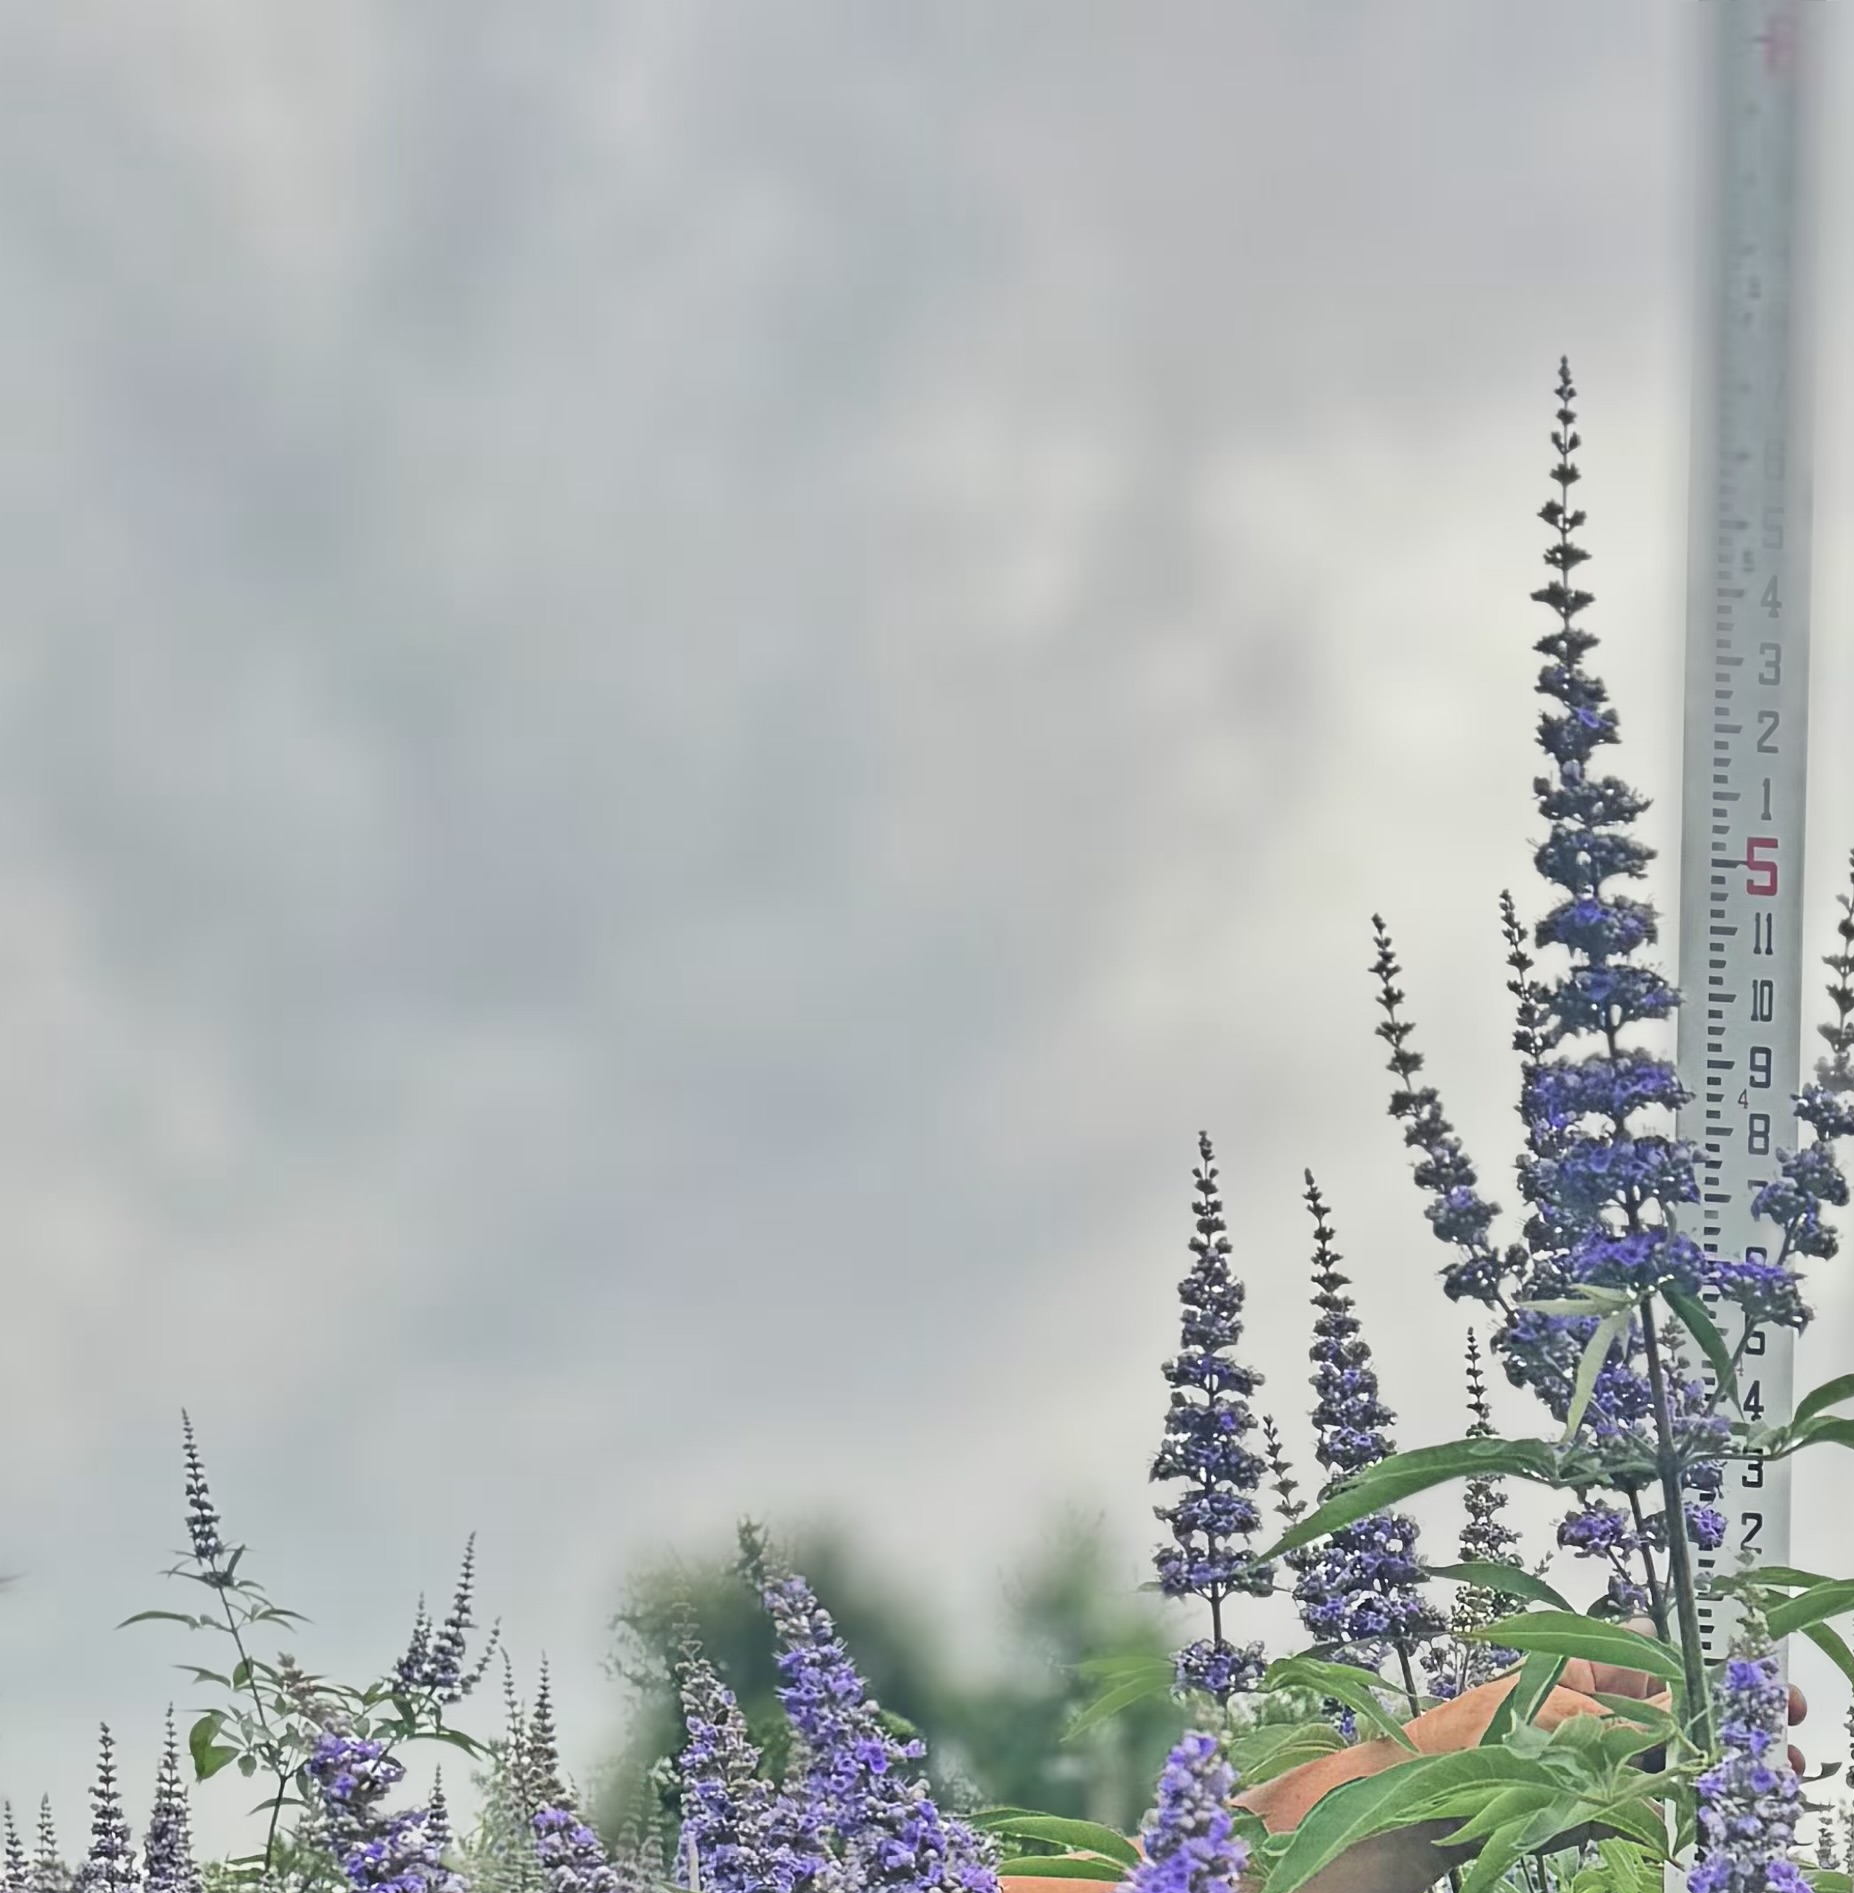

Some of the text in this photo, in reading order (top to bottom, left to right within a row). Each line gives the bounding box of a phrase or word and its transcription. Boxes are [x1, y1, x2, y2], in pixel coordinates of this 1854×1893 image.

[1763, 507, 1784, 549] 5
[1760, 575, 1782, 618] 4
[1758, 642, 1781, 685] 3
[1757, 711, 1779, 753] 2
[1762, 778, 1771, 820] 1
[1746, 837, 1778, 896] 5
[1753, 912, 1773, 955] 11
[1751, 979, 1773, 1022] 10
[1749, 1046, 1772, 1089] 9
[1737, 1088, 1749, 1109] 4
[1747, 1113, 1771, 1155] 8
[1743, 1380, 1764, 1421] 4
[1742, 1448, 1764, 1488] 3
[1740, 1512, 1762, 1554] 2
